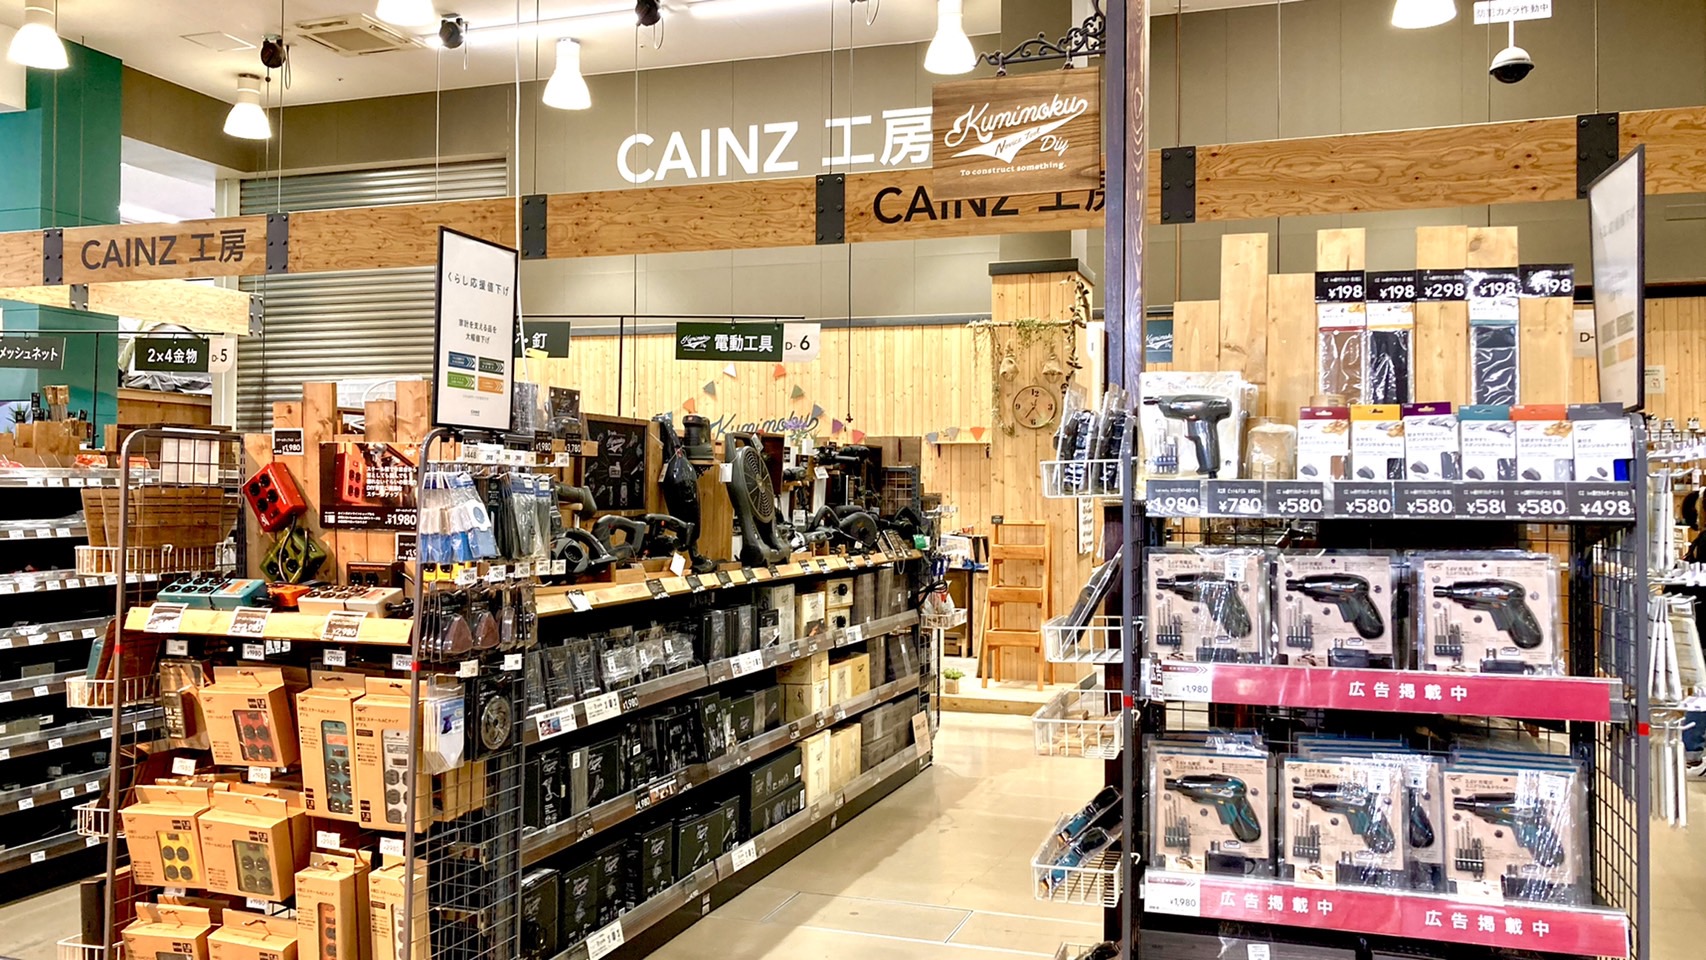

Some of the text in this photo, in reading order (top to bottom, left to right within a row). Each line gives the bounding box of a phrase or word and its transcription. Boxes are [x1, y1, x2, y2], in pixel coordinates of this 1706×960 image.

[944, 93, 1089, 148] Kumimoku
[616, 106, 933, 184] CAINZ 工房
[1040, 135, 1070, 157] Diy
[960, 161, 1067, 177] To construct something.
[81, 228, 247, 271] CAINZ 工房
[447, 271, 511, 297] くらし応援値下げ
[1328, 284, 1363, 299] ¥198
[1379, 284, 1415, 299] ¥198
[1424, 282, 1465, 298] ¥298
[713, 333, 774, 353] 電動工具
[1579, 331, 1595, 343] D-
[1218, 497, 1262, 513] ¥780
[1278, 498, 1323, 514] ¥580
[1346, 498, 1391, 514] ¥580
[1406, 498, 1453, 514] ¥580
[1517, 499, 1566, 515] ¥580
[1580, 499, 1632, 516] ¥498
[1182, 685, 1209, 695] ¥1,980
[1348, 680, 1469, 703] 広告掲載中
[1170, 897, 1197, 908] ¥1,980
[1220, 891, 1334, 919] 広告掲載中
[1424, 909, 1551, 938] 広告掲載中
